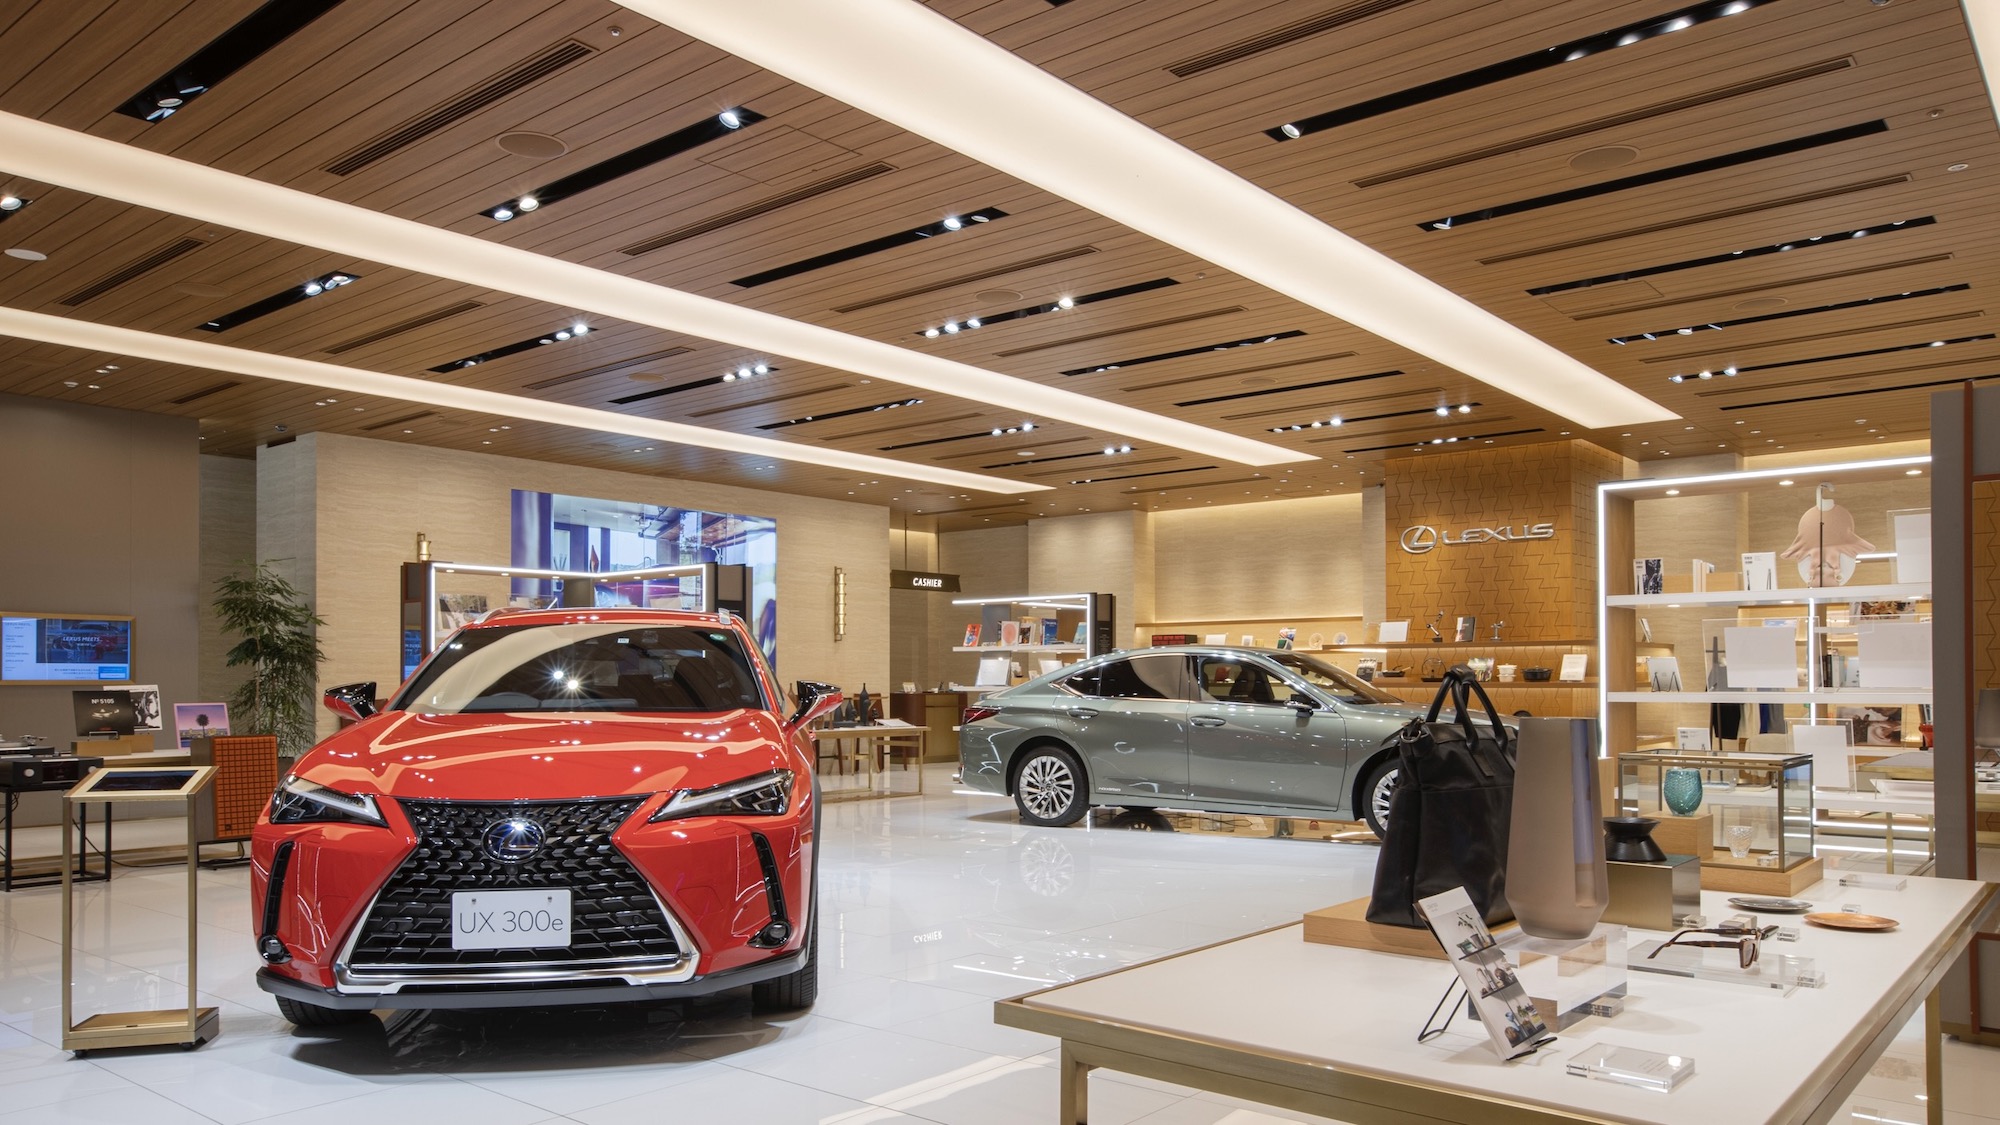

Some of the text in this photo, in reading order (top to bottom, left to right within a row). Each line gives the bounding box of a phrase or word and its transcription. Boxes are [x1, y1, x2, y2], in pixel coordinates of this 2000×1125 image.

[1441, 523, 1554, 545] LEXUS
[912, 577, 943, 588] CASHIER
[459, 910, 564, 934] UX 300e
